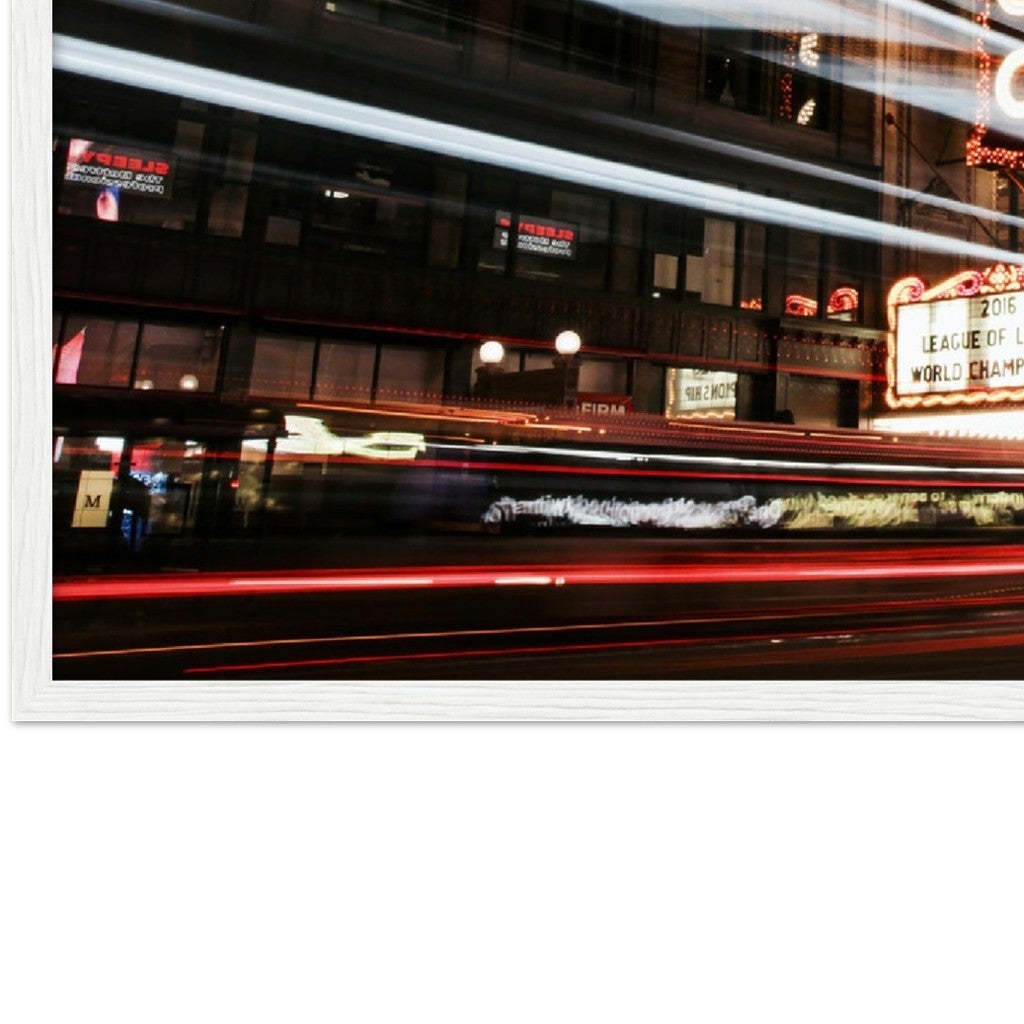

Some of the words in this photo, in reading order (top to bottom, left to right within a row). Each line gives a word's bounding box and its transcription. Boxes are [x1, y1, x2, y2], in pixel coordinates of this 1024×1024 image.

[980, 296, 1017, 319] 2016
[922, 329, 982, 354] LEAGUE
[987, 329, 1006, 348] OF
[911, 362, 963, 383] WORLD
[84, 494, 102, 509] M
